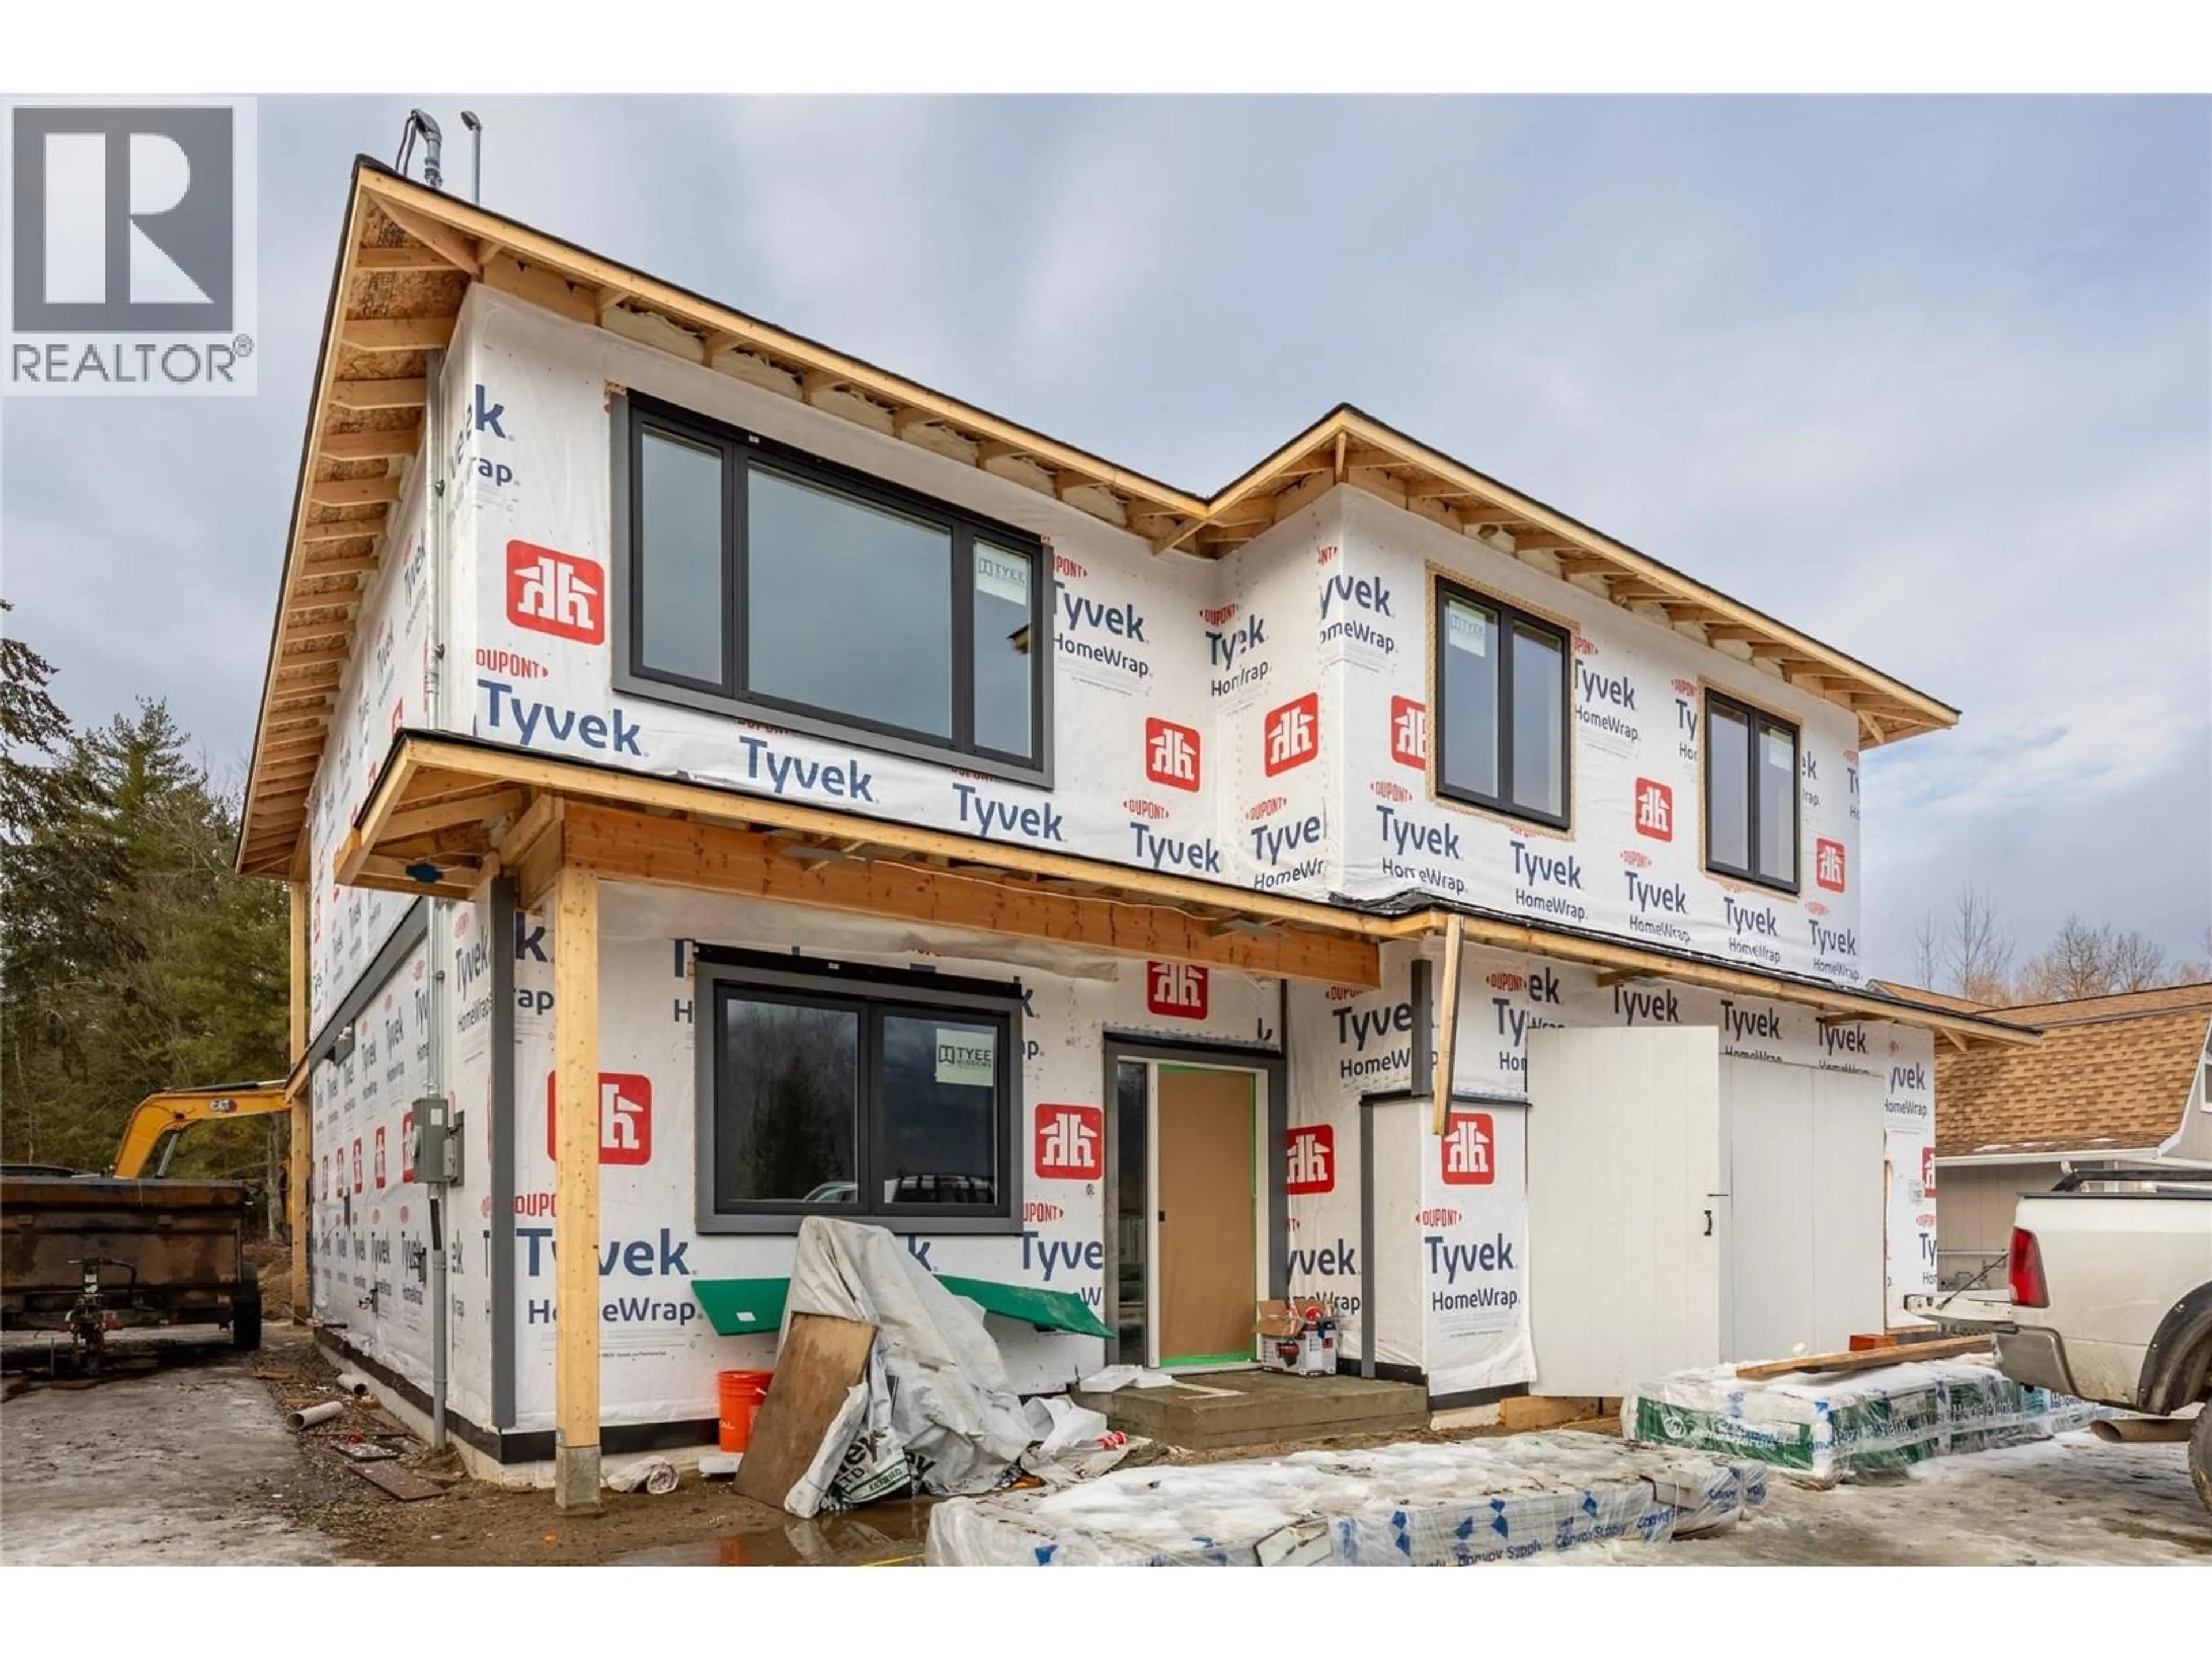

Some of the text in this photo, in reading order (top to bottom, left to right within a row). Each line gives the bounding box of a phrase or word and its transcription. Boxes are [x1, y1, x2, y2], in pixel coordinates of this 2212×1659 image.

[1320, 575, 1391, 620] yvek
[478, 680, 642, 756] Tyvek
[740, 735, 873, 802] Tyvek
[952, 783, 1063, 842] Tyvek
[1129, 799, 1165, 819] DUPONT
[1249, 797, 1282, 820] DUPONT
[1375, 781, 1408, 802] DUPONT
[1130, 821, 1220, 873] Tyvek
[1251, 804, 1326, 865] Tyve
[1376, 805, 1460, 860] Tyvek
[1254, 857, 1324, 890] HomeWr
[1510, 840, 1581, 889] Tyvek
[1516, 888, 1585, 922] HomeWrap
[1624, 870, 1687, 915] Tyvek
[1724, 896, 1778, 937] Tyvek
[1808, 919, 1857, 956] Tyvek
[456, 925, 488, 1002] Tyvek
[1332, 1003, 1412, 1051] Tyve
[1615, 984, 1679, 1026] Tyvek
[1720, 999, 1779, 1042] Tyvek
[956, 1047, 992, 1061] TYEE
[1815, 1017, 1866, 1056] Tyvek
[1422, 1208, 1457, 1227] DUPONT
[516, 1228, 689, 1277] Tvek
[1017, 1231, 1103, 1282] Tyve
[1424, 1232, 1514, 1285] Tyvek
[1432, 1287, 1518, 1312] HomeWrap
